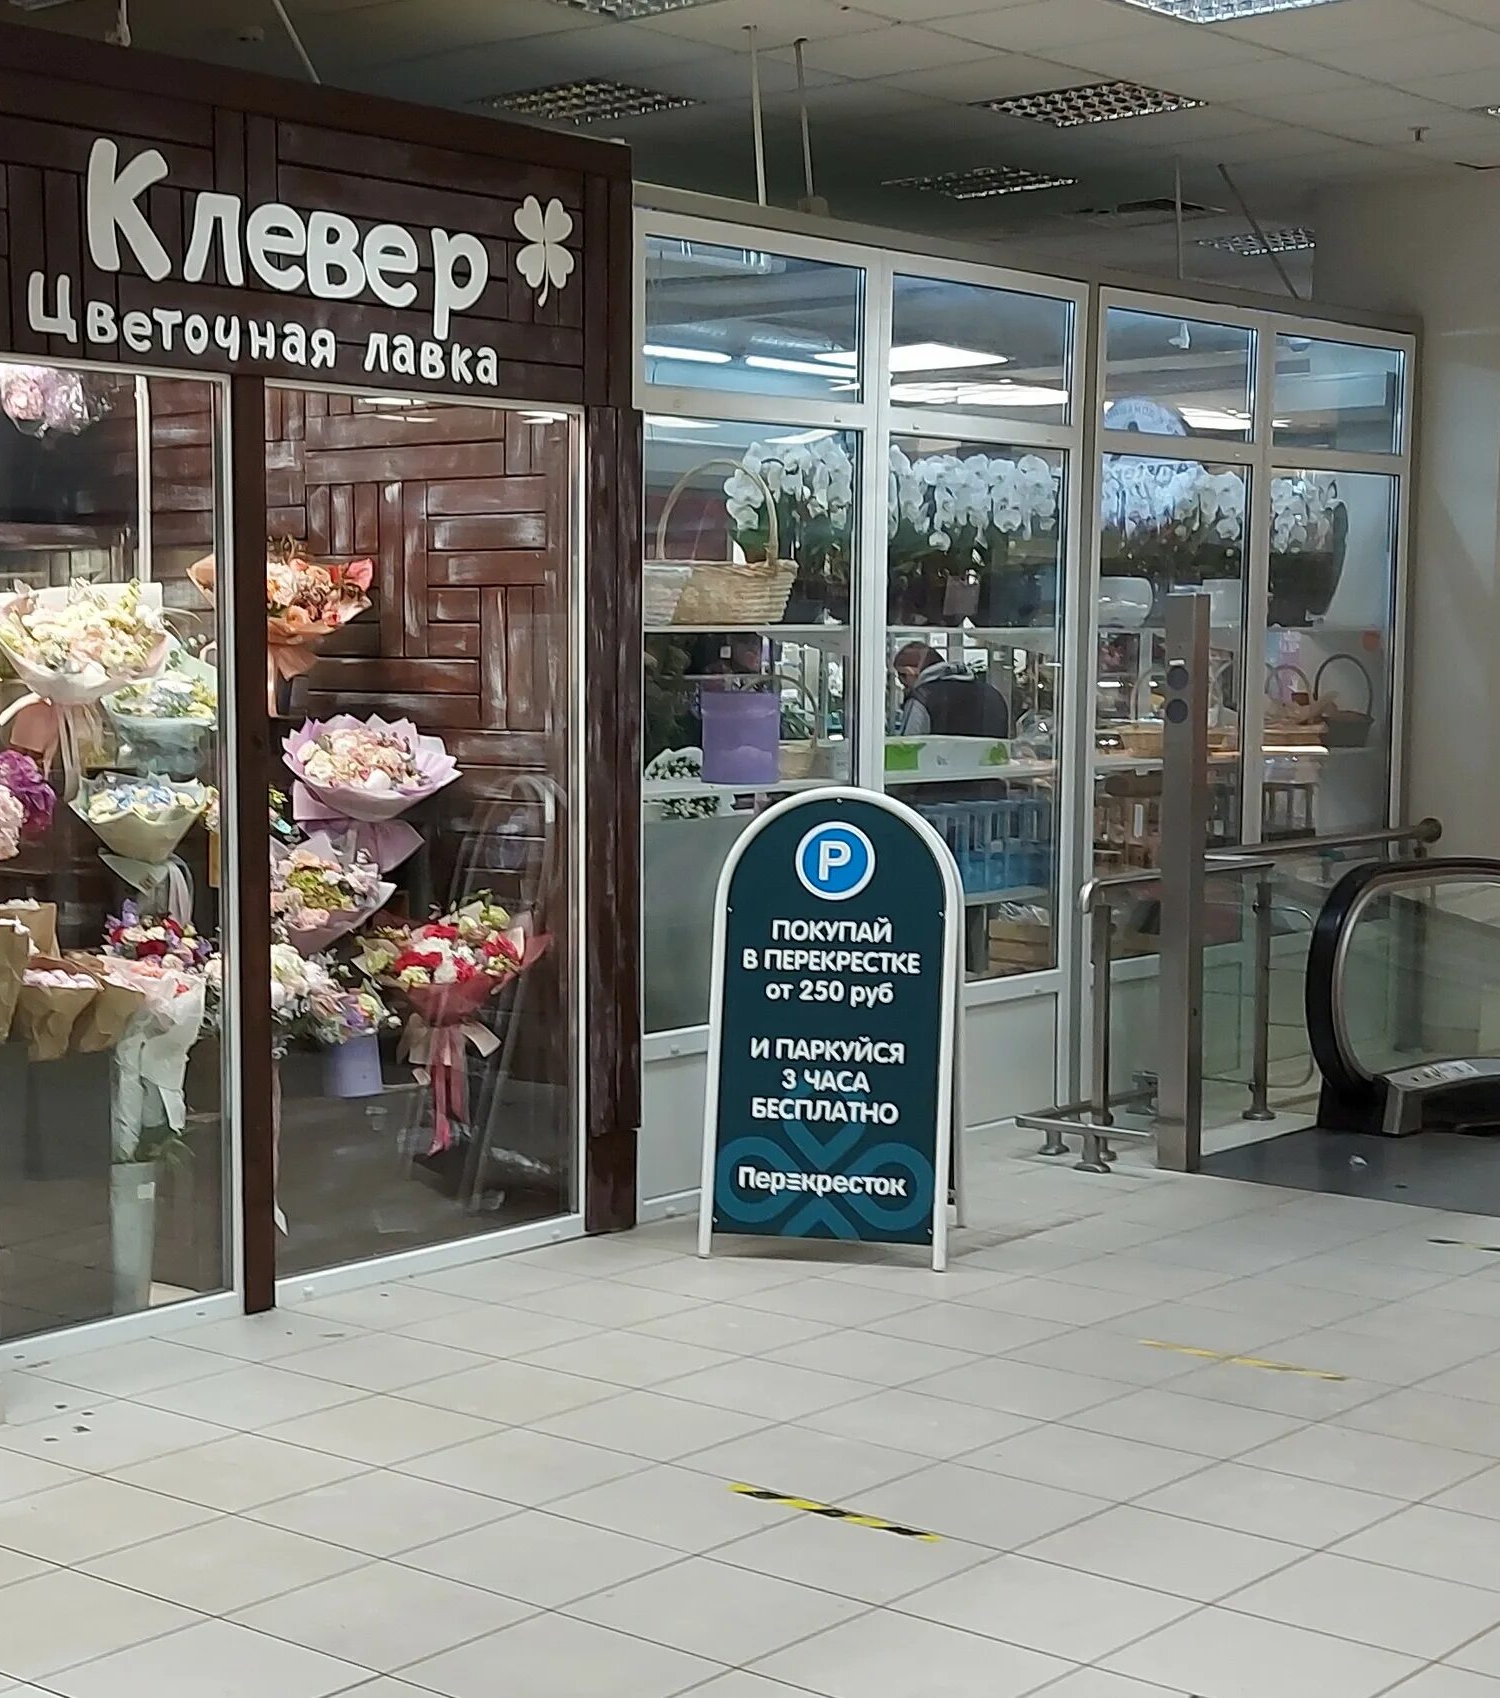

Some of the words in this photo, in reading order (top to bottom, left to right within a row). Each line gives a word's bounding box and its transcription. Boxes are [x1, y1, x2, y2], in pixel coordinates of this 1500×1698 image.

[86, 137, 489, 340] Клевер
[28, 270, 337, 369] Цветочная
[364, 331, 500, 387] лавка
[772, 916, 892, 943] ПОКУПАЙ
[742, 948, 759, 970] В
[764, 949, 921, 974] ПЕРЕКРЕСТКЕ
[765, 983, 794, 1000] от
[798, 979, 845, 1002] 250
[850, 982, 894, 1008] руб
[750, 1037, 770, 1059] И
[775, 1036, 905, 1064] ПАРКУЙСЯ
[781, 1068, 797, 1090] 3
[803, 1069, 871, 1093] ЧАСА
[751, 1097, 899, 1125] БЕСПЛАТНО
